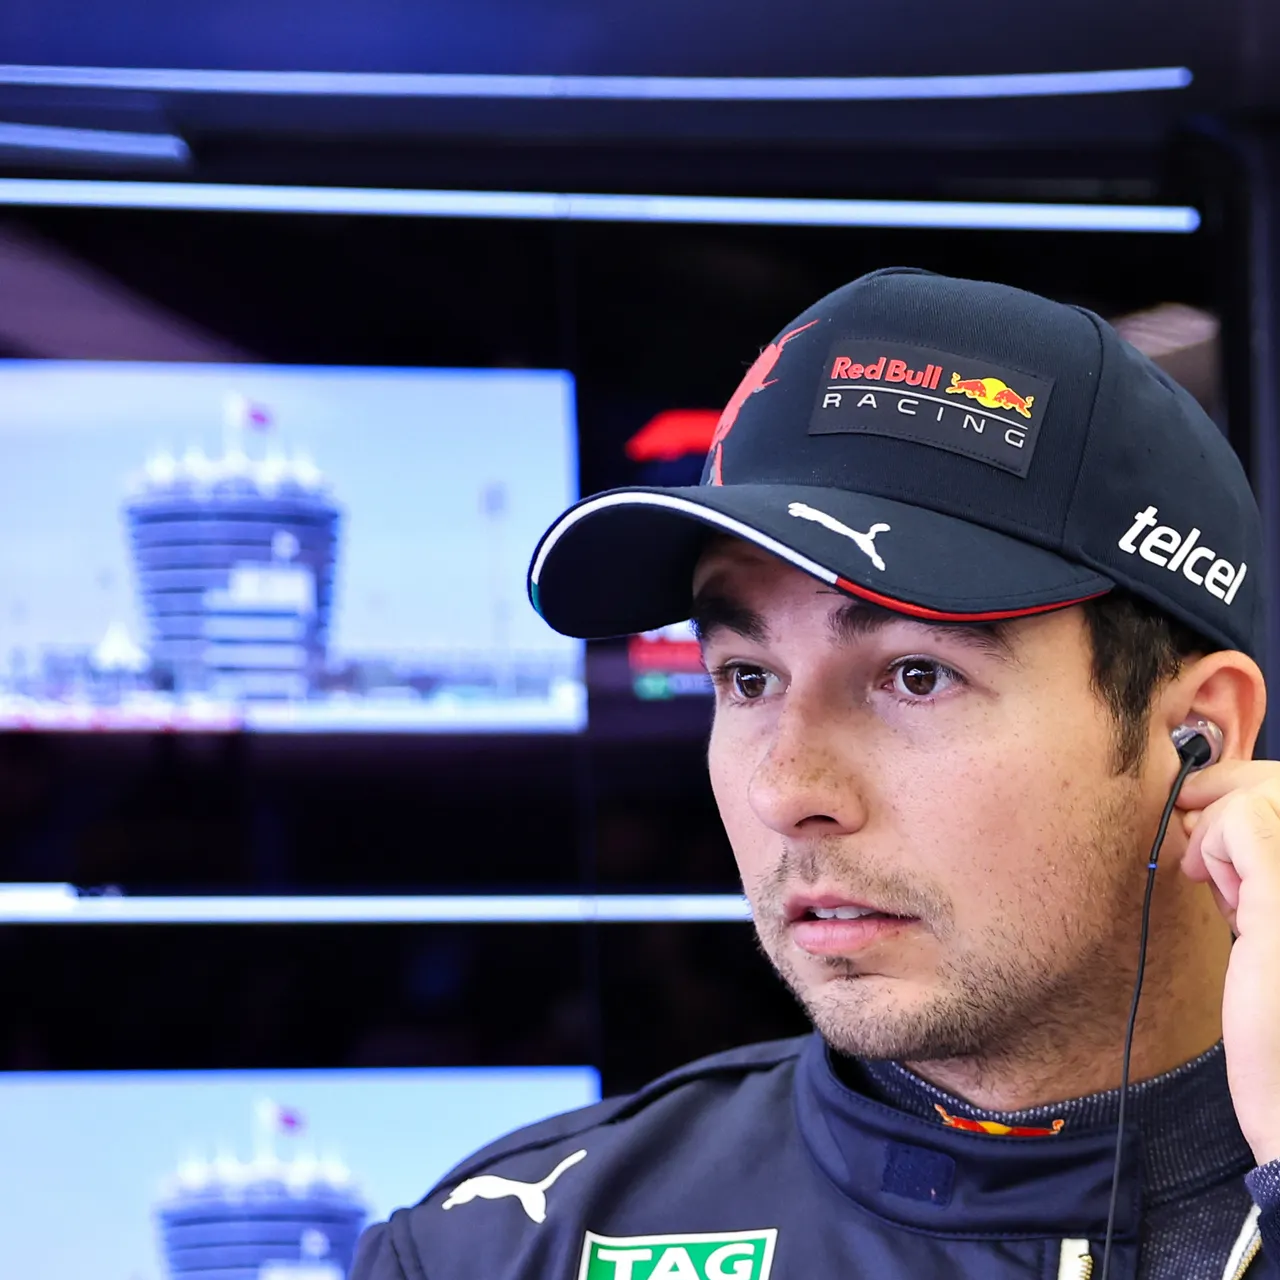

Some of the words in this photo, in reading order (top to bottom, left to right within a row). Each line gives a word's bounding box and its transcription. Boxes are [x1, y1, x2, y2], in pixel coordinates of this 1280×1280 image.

[831, 357, 886, 380] Red
[884, 360, 943, 390] Bull
[822, 393, 1026, 448] RACING
[1118, 505, 1248, 605] telcel
